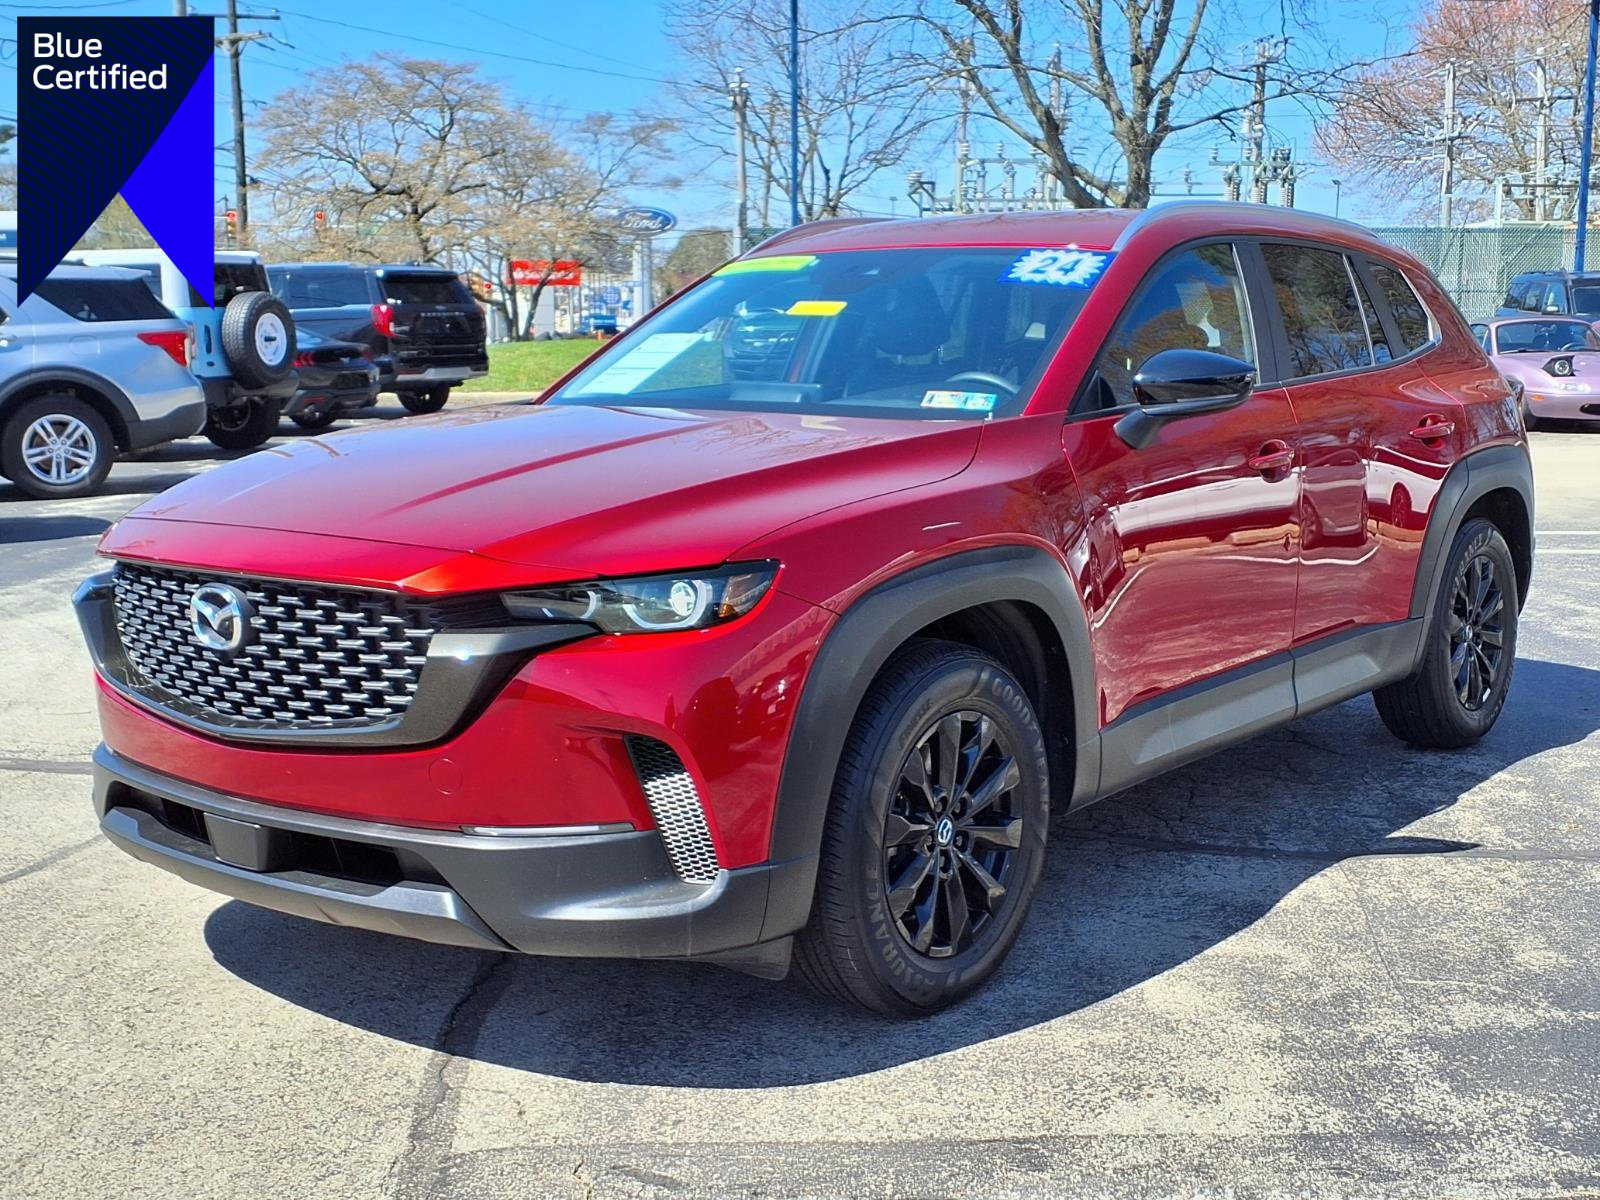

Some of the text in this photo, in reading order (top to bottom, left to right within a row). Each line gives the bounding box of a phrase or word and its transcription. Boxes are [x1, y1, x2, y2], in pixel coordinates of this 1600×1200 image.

[621, 211, 664, 230] Ford
[1027, 255, 1084, 276] 24
[991, 677, 1050, 814] GOODYEAR
